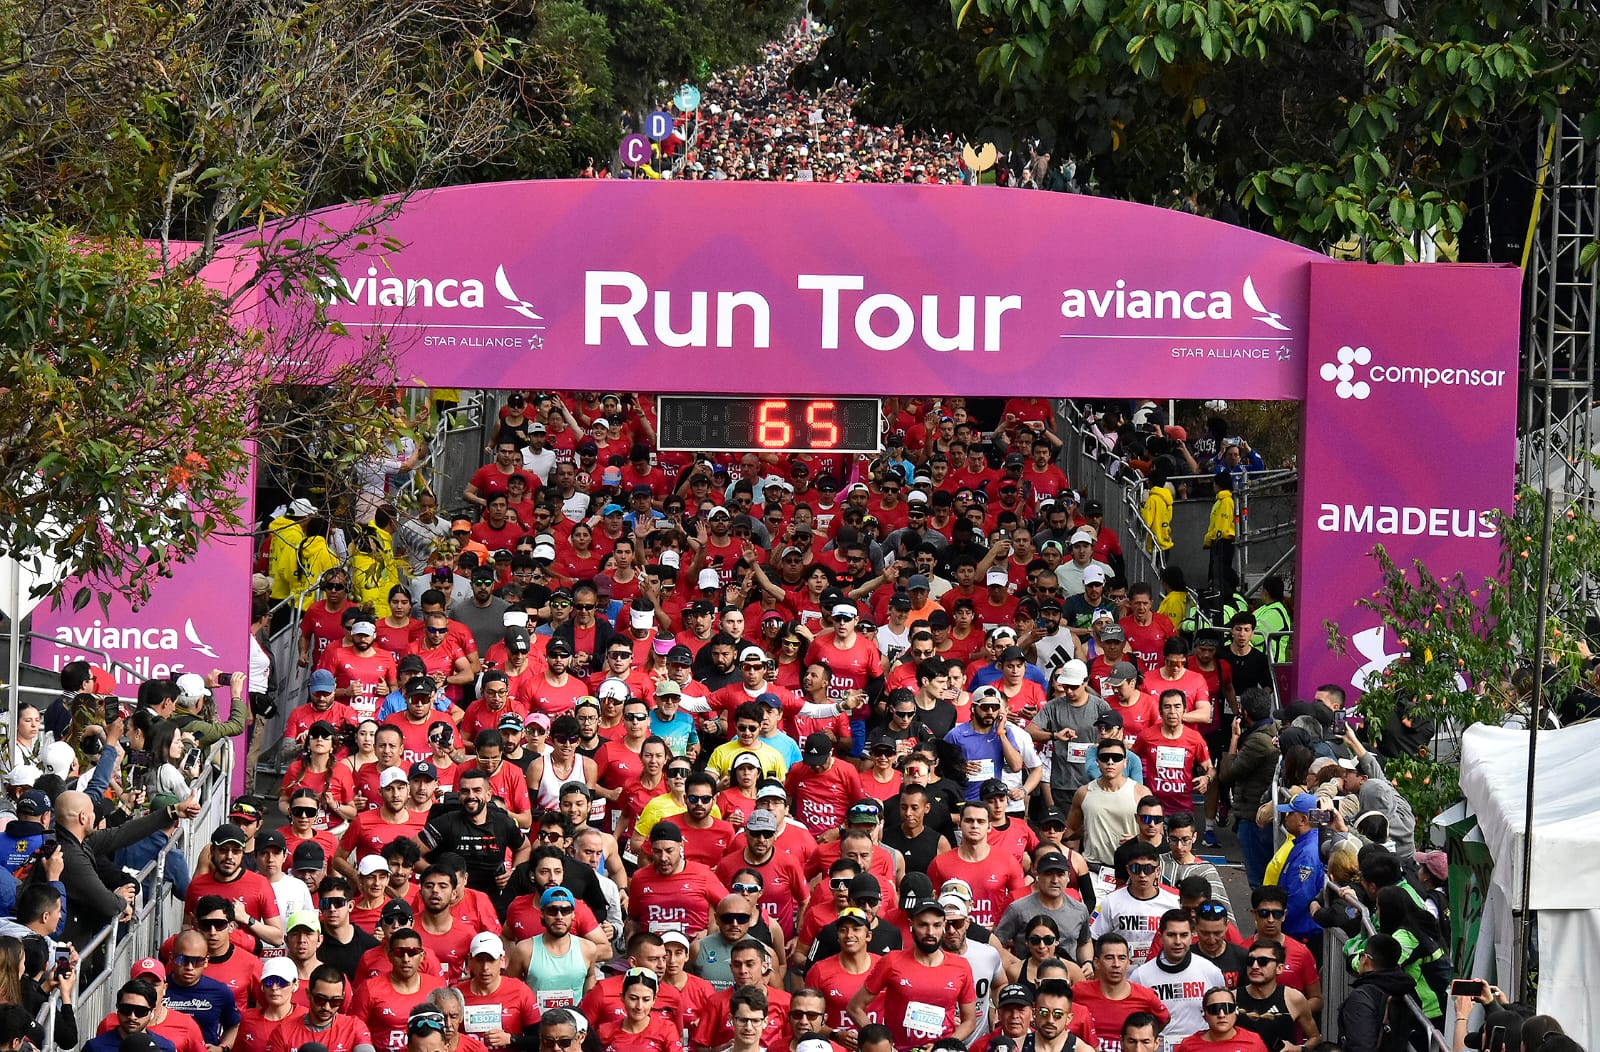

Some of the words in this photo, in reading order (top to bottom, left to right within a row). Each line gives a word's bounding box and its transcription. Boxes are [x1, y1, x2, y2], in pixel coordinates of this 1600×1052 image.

[652, 115, 665, 137] D
[628, 138, 643, 162] C
[1060, 279, 1232, 320] avianca
[584, 270, 770, 349] Run
[797, 274, 1022, 352] Tour
[423, 336, 456, 347] STAR
[459, 336, 522, 348] ALLIANCE
[1171, 348, 1204, 359] STAR
[1207, 348, 1270, 359] ALLIANCE
[1369, 365, 1506, 388] compensar
[54, 620, 178, 650] avianca
[53, 654, 185, 685] lmiles
[1156, 767, 1185, 780] Run
[1154, 777, 1187, 793] Tour
[802, 799, 834, 813] Run
[802, 810, 838, 826] Tour
[648, 904, 686, 920] Run
[971, 899, 992, 912] un
[1118, 915, 1162, 931] SYNERG
